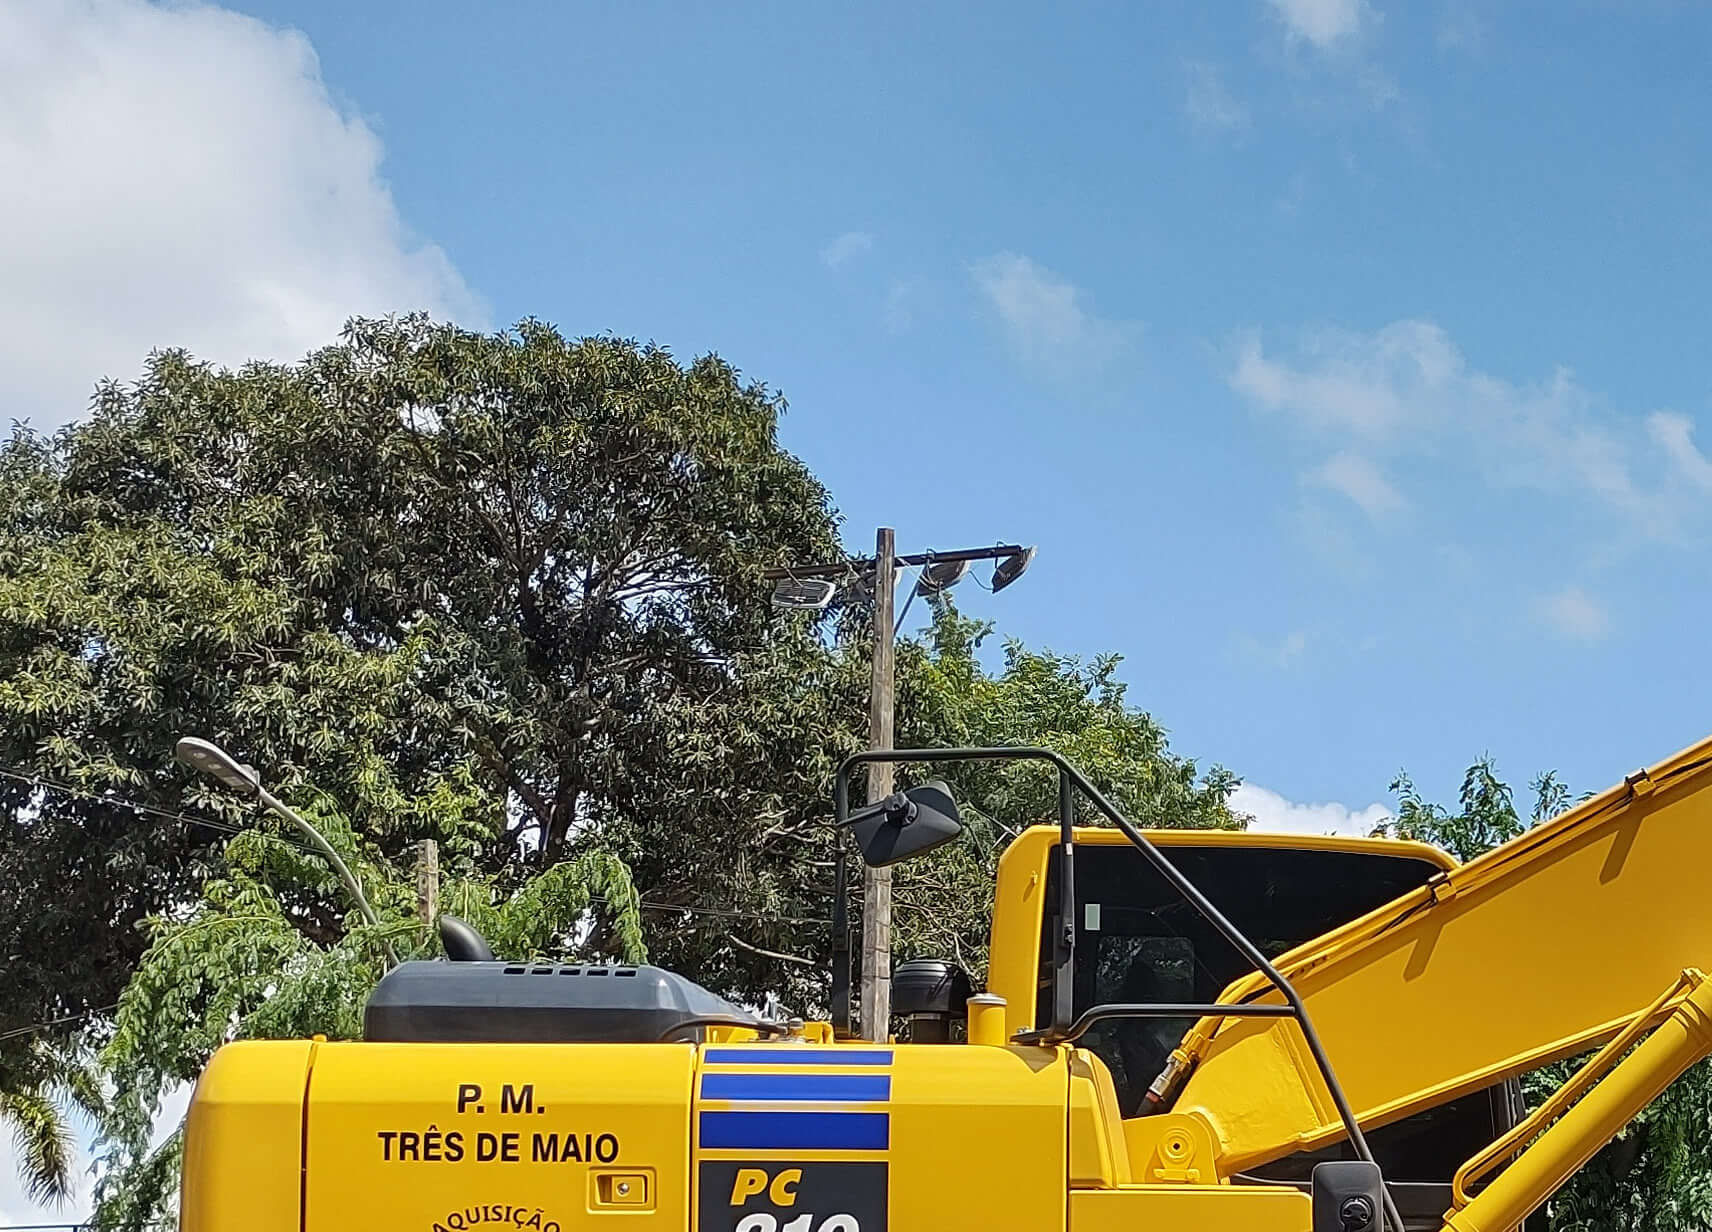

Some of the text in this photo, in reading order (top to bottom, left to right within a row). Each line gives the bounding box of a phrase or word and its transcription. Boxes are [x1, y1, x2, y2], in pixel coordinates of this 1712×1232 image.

[457, 1084, 545, 1114] P. M.
[378, 1124, 619, 1163] TRÊS DE MAIO
[729, 1168, 803, 1207] PC
